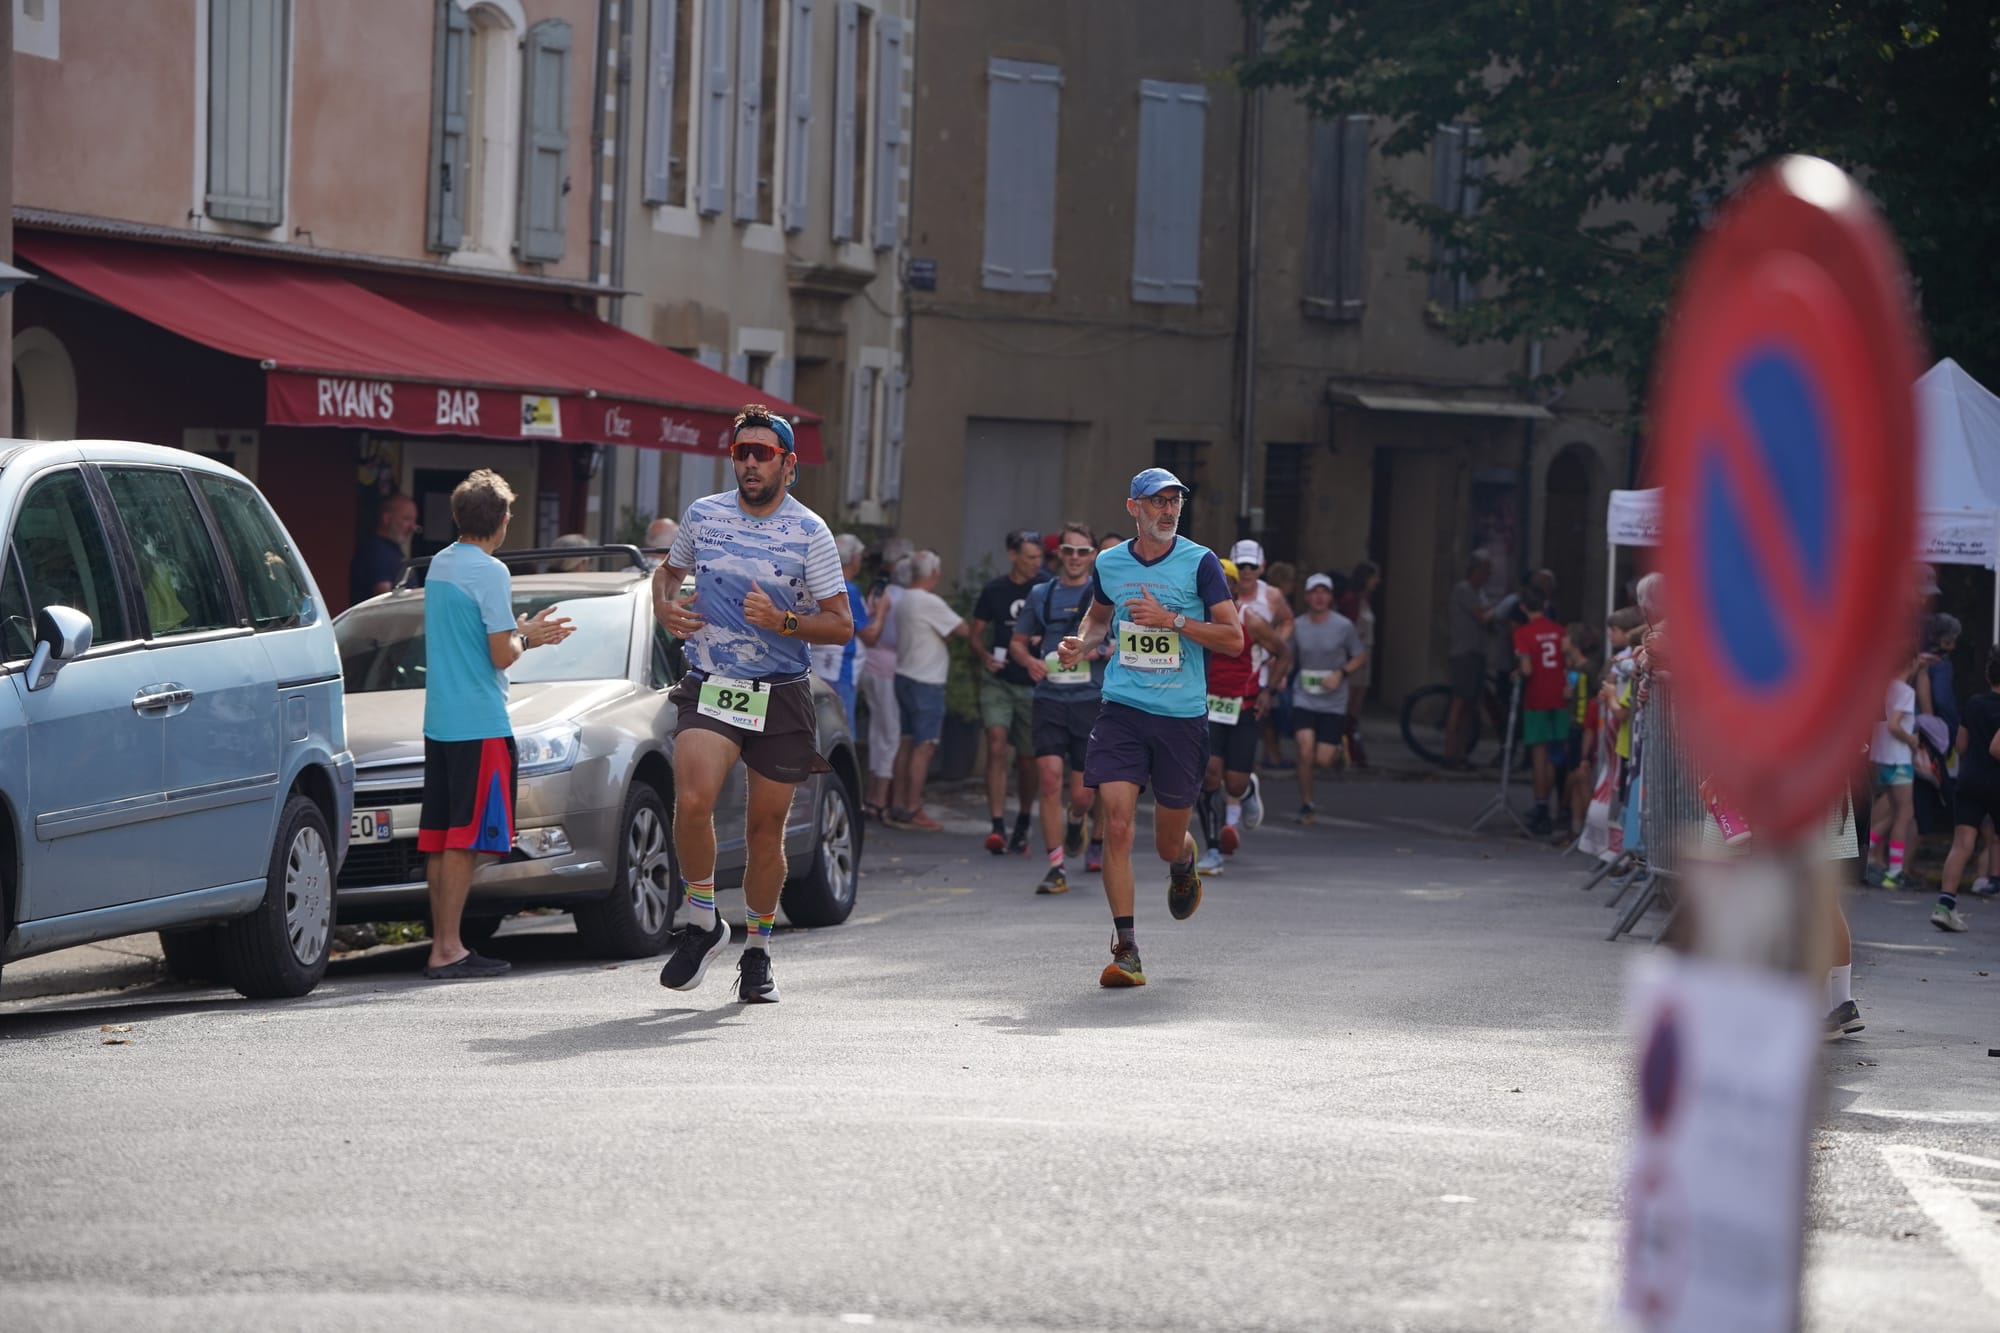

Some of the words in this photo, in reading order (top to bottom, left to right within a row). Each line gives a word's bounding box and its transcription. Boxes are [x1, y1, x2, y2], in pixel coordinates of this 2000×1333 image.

[317, 379, 394, 419] RYAN'S
[436, 389, 480, 426] BAR
[1127, 634, 1170, 653] 196
[1541, 641, 1558, 668] 2
[717, 690, 750, 712] 82
[1208, 700, 1234, 714] 126
